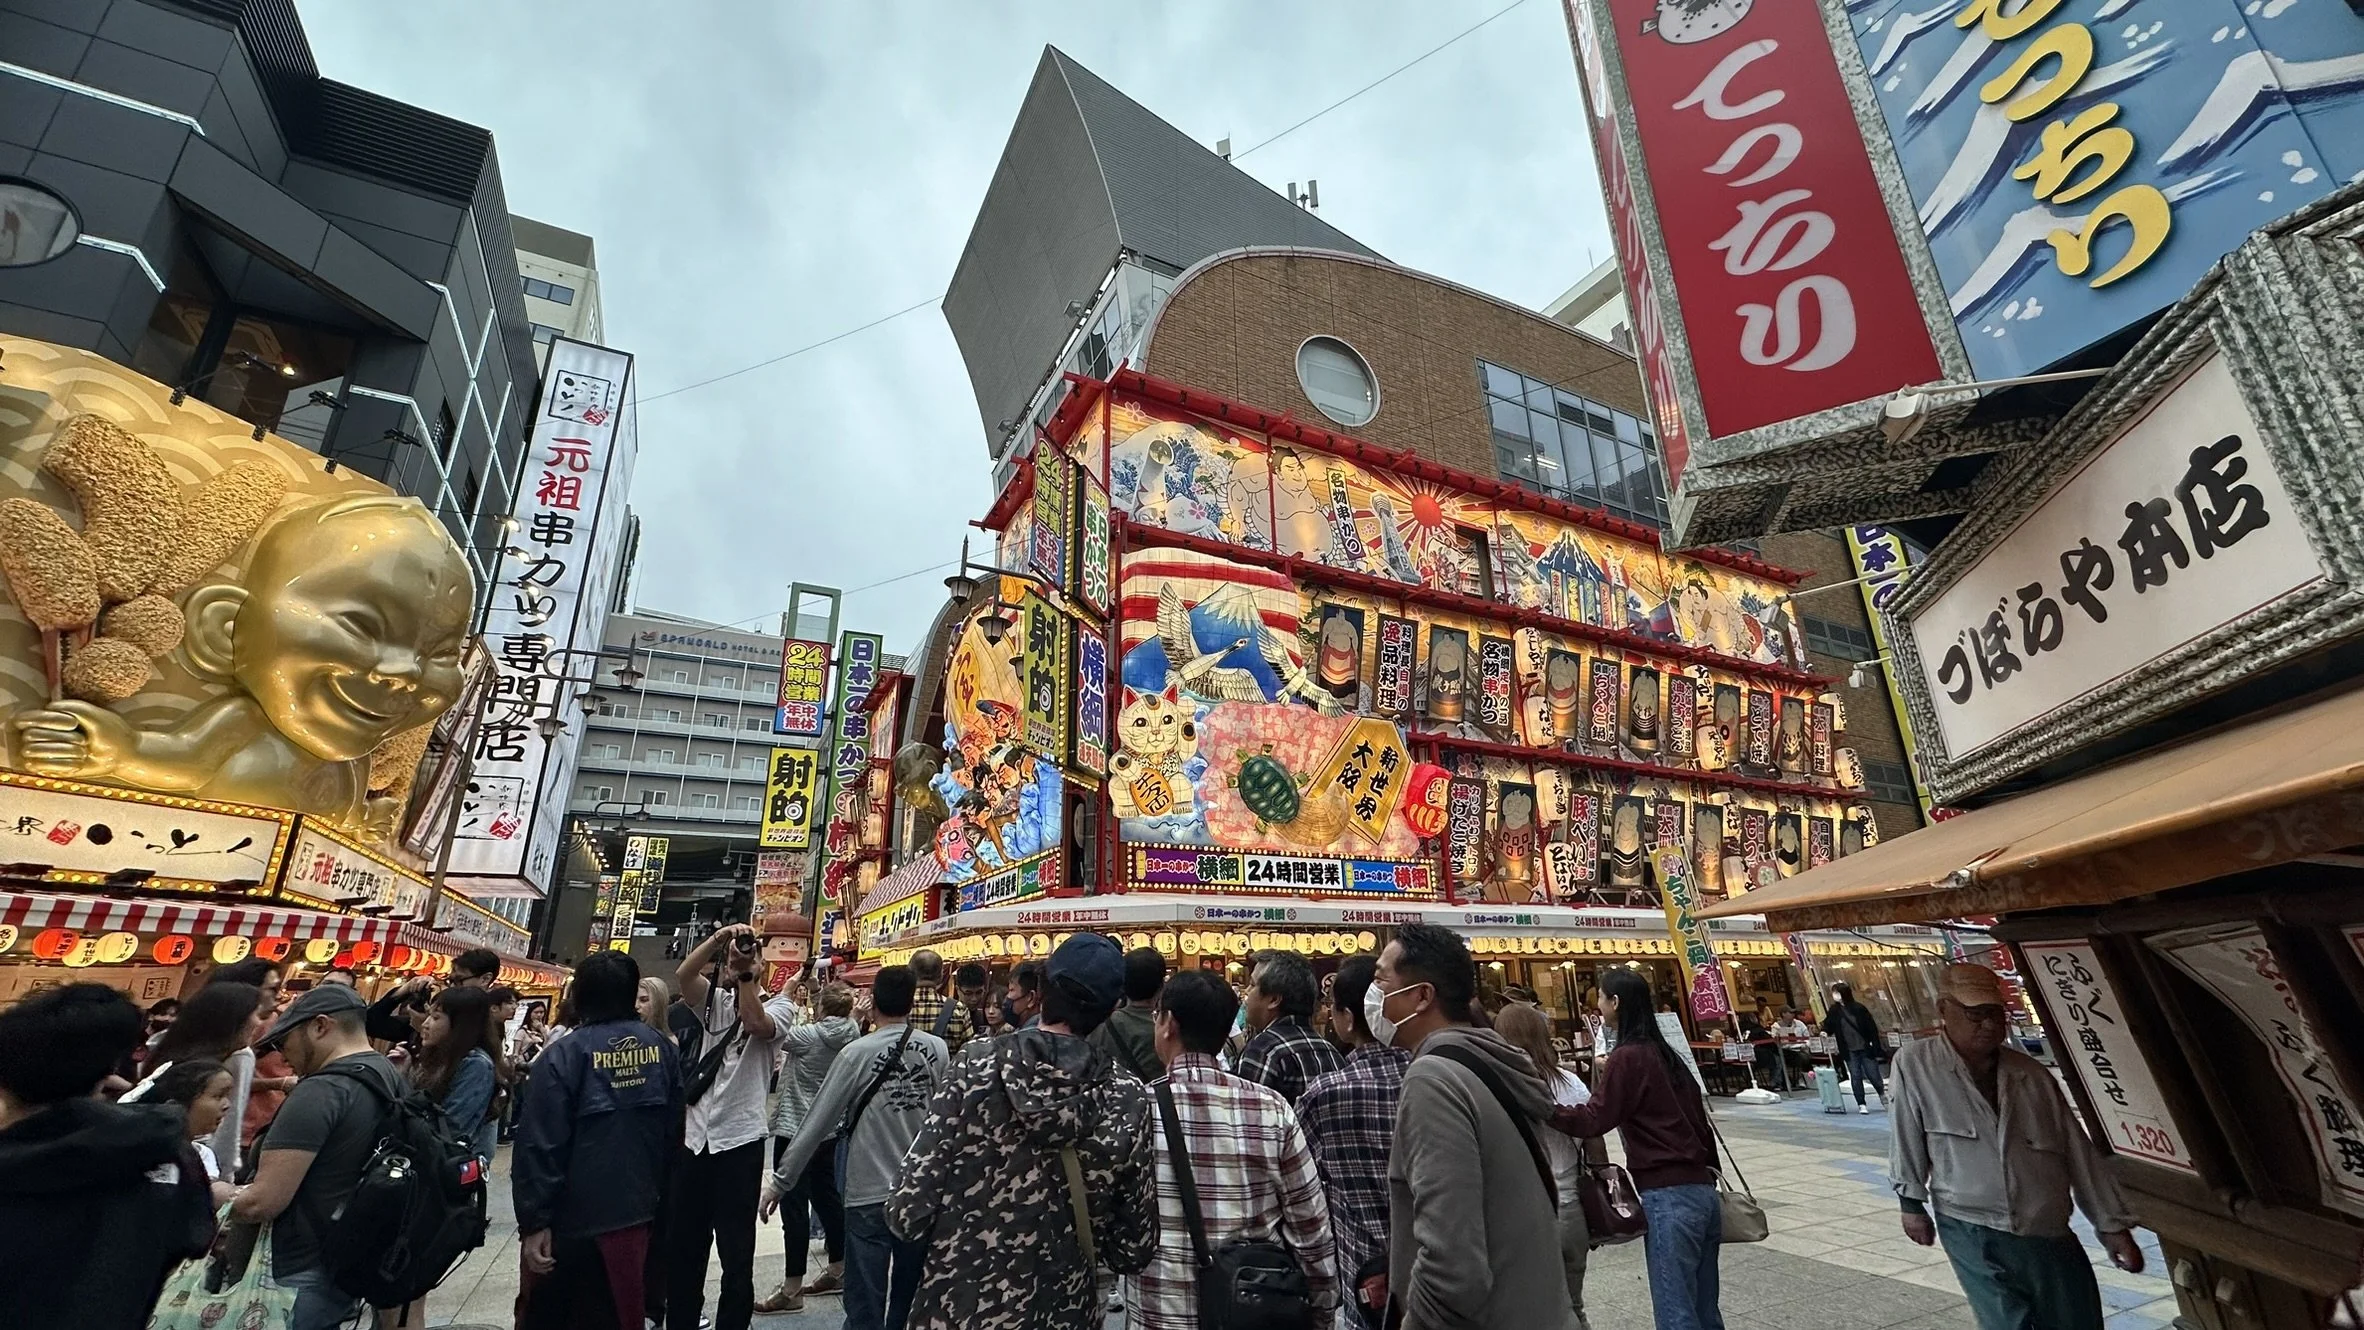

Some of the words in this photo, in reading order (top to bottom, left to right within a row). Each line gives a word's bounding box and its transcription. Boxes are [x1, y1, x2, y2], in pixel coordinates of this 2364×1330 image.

[1673, 39, 1857, 371] てっちり
[1937, 435, 2269, 704] づぼらや本店
[786, 643, 825, 668] 24
[1028, 603, 1058, 723] 射的
[1378, 620, 1401, 711] 逸品料理
[785, 665, 823, 685] 時間
[1079, 630, 1106, 748] 横綱
[1480, 641, 1501, 724] 名物串かつ
[782, 683, 822, 703] 営業
[1591, 673, 1609, 741] ちゃんこ鍋
[783, 716, 817, 731] 無休
[784, 703, 817, 718] 年中
[834, 638, 876, 793] 日本一の串かつ
[1671, 680, 1685, 753] 油かすうどん
[1336, 740, 1374, 794] 大阪
[1355, 745, 1399, 822] 新世界
[772, 753, 813, 826] 射的
[766, 834, 806, 843] チャンピオン
[1450, 783, 1470, 875] 揚げたこ焼き
[1196, 854, 1240, 881] 横綱
[1247, 858, 1341, 886] 24時間営業
[1393, 865, 1429, 890] 横綱
[984, 873, 1017, 903] 24時間営業
[1018, 911, 1071, 923] 24時間営業
[1207, 908, 1261, 919] 日本一の串かつ
[1264, 908, 1286, 921] 横綱
[1342, 910, 1391, 923] 24時間営業
[608, 1036, 643, 1051] The
[2041, 954, 2129, 1107] にぎり盛合せ
[593, 1046, 659, 1069] PREMIUM
[2120, 1121, 2176, 1157] 1,320
